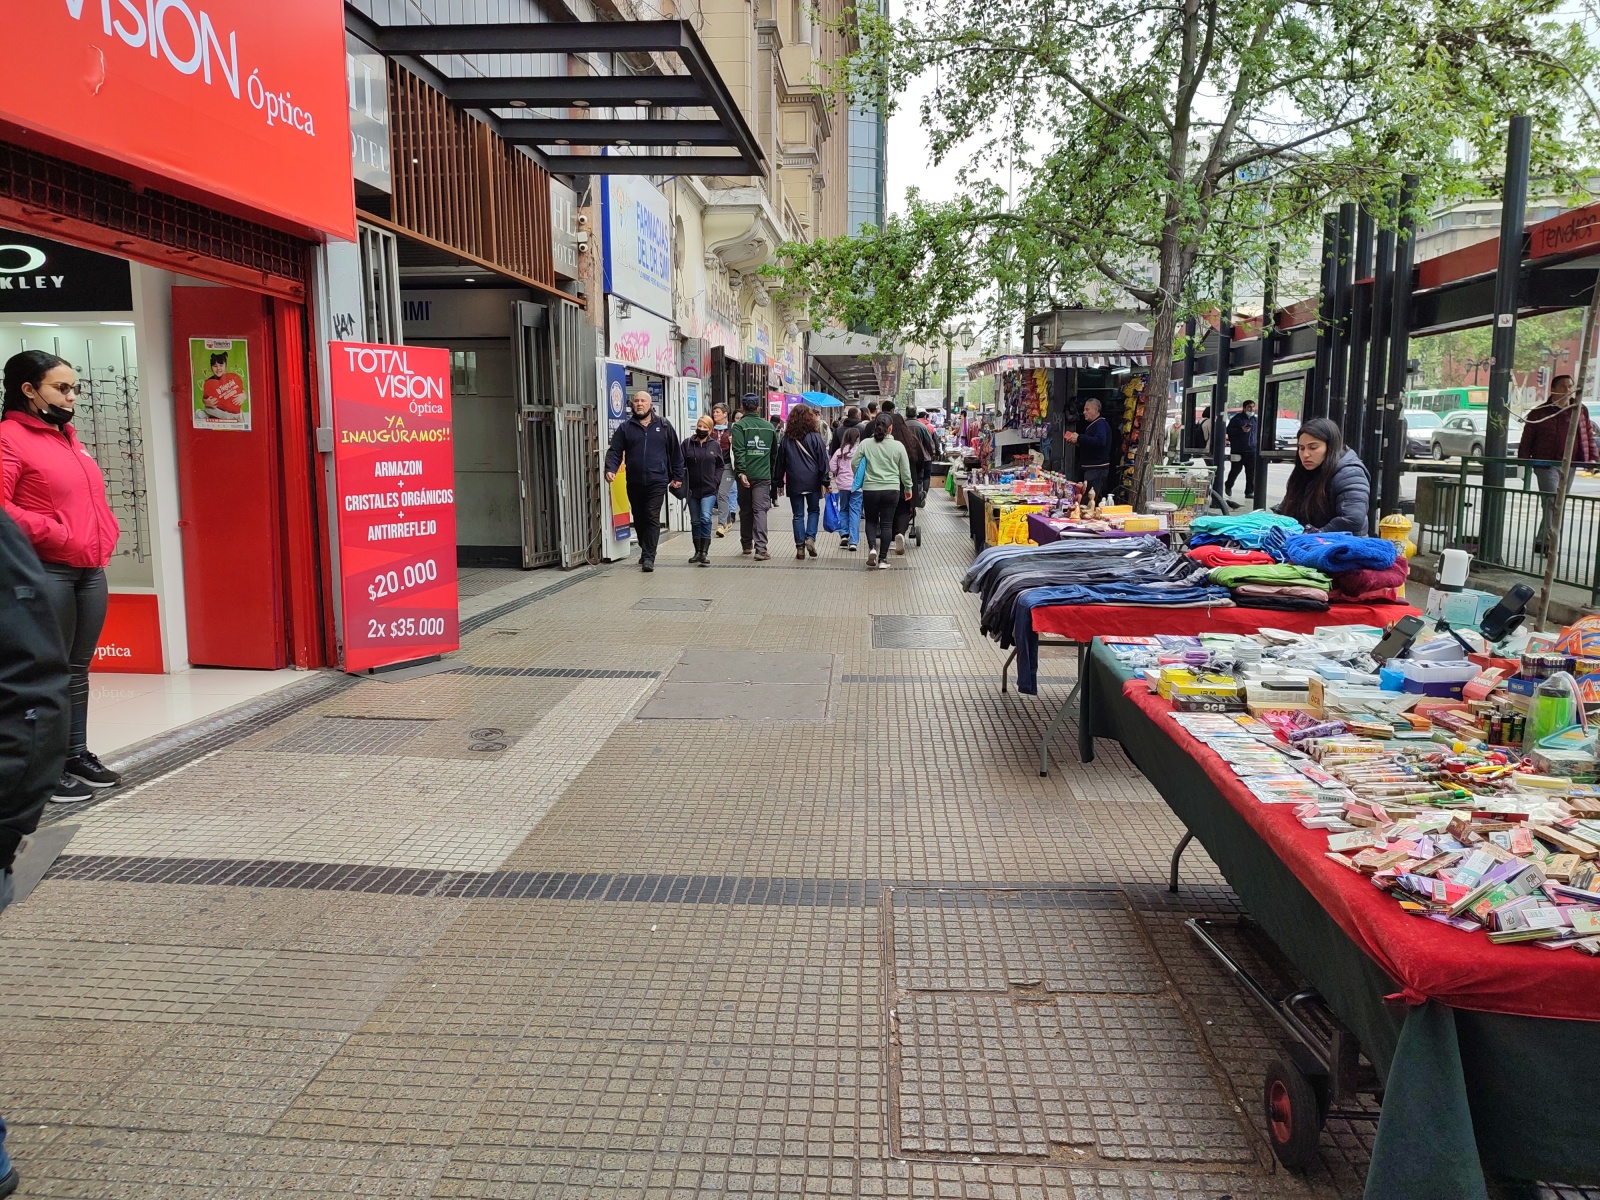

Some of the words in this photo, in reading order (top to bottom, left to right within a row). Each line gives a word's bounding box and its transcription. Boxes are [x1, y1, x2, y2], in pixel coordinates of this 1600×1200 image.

[65, 0, 240, 99] SION
[247, 68, 315, 136] Óptica
[636, 200, 669, 254] FARMACIAS
[553, 241, 577, 268] HOTEL
[638, 235, 650, 270] DEL
[343, 347, 415, 375] TOTAL
[374, 374, 443, 399] VISION
[409, 399, 444, 417] Óptica
[384, 415, 405, 429] YA
[341, 427, 451, 443] INAUGURAMOS!!
[374, 460, 423, 477] ARMAZON
[345, 492, 400, 511] CRISTALES
[400, 487, 454, 507] ORGÁNICOS
[367, 520, 437, 541] ANTIRREFLEJO
[367, 559, 437, 602] $20.000
[367, 619, 387, 638] 2x
[389, 617, 445, 639] $35.000
[1203, 703, 1226, 712] OCB
